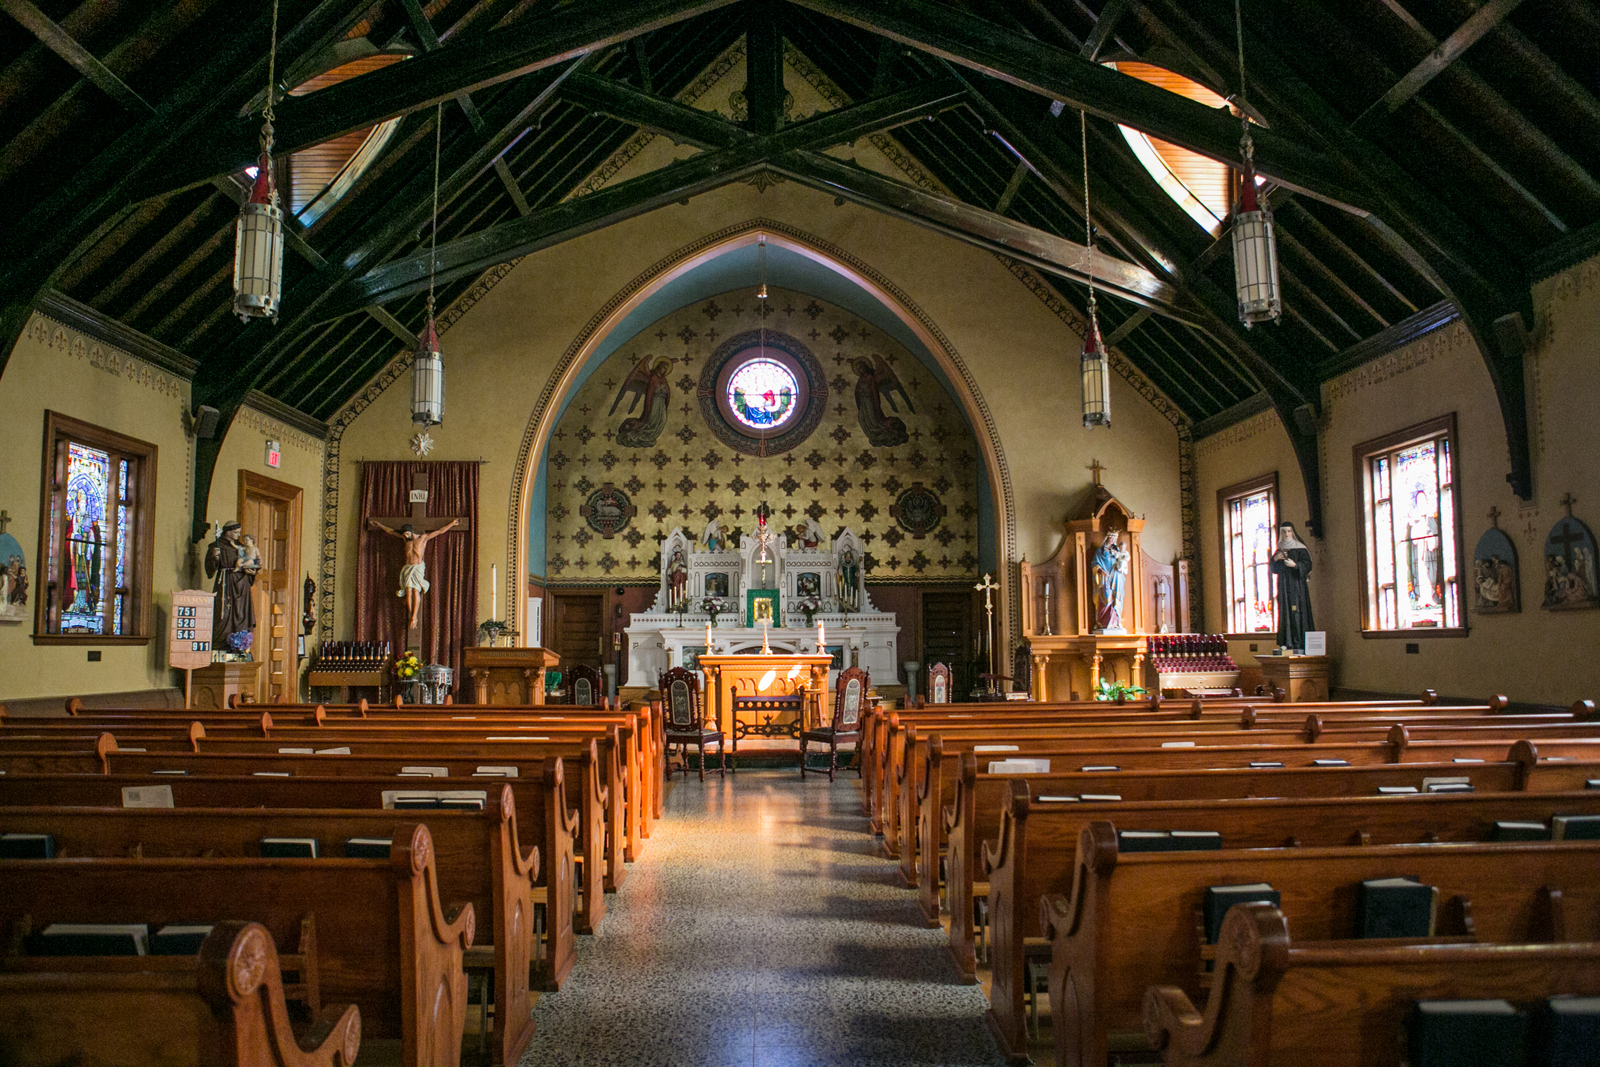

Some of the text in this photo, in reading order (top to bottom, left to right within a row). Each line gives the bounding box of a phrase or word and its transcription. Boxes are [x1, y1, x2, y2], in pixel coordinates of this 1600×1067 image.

[411, 492, 426, 501] INRI
[178, 606, 196, 617] 751
[177, 618, 195, 628] 528
[177, 630, 195, 639] 543
[192, 642, 209, 651] 911
